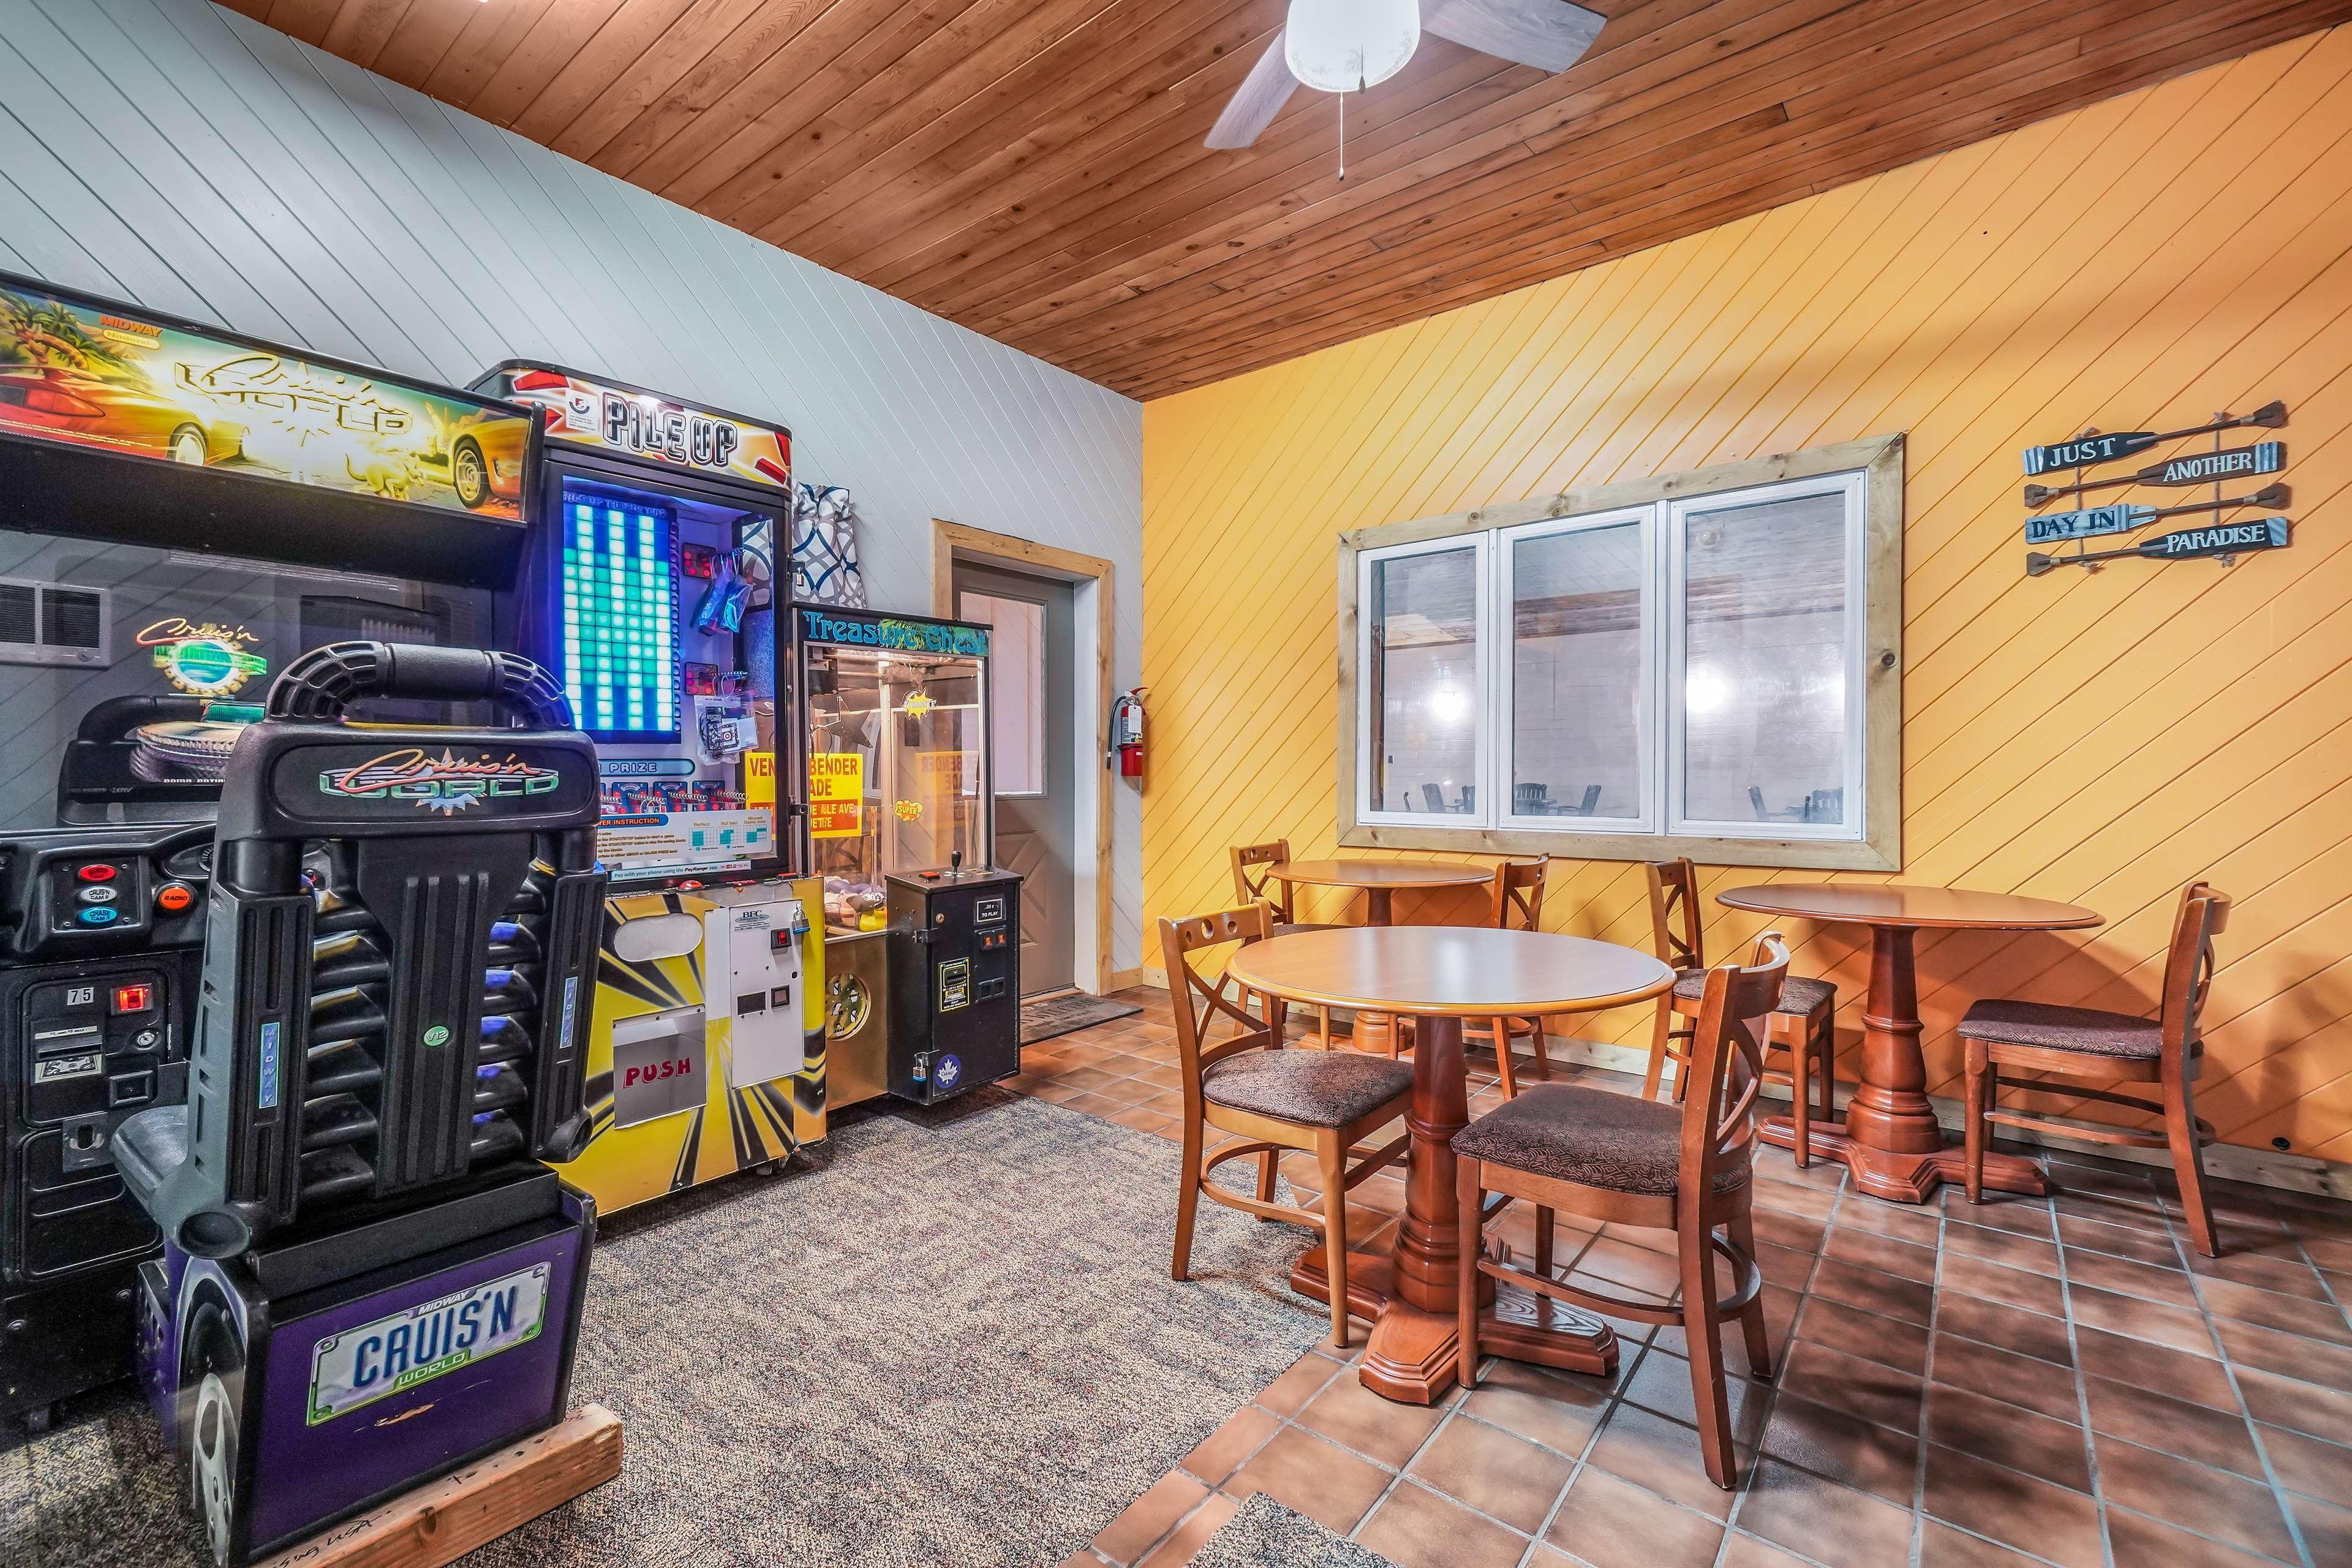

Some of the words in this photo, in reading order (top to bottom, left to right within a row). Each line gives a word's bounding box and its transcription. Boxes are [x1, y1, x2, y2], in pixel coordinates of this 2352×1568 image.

[100, 314, 163, 337] MIDWAY
[603, 392, 686, 463] PILE
[690, 416, 737, 467] UP
[2049, 437, 2116, 467] JUST
[2163, 452, 2253, 483] ANOTHER
[2031, 515, 2079, 538] DAY
[2089, 510, 2115, 530] IN
[2166, 525, 2266, 553] PARADISE
[136, 617, 260, 646] Cruis'n
[803, 611, 917, 648] Treasure
[925, 625, 989, 654] Chest
[339, 748, 542, 793] Cruis'n
[609, 762, 657, 774] PRIZE
[750, 758, 775, 777] VEN
[318, 773, 559, 799] WORLD
[809, 778, 832, 796] ADE
[71, 989, 91, 1003] 75
[426, 1031, 447, 1042] V12
[264, 1028, 275, 1102] MIDWAY
[623, 1057, 691, 1089] PUSH
[418, 1291, 470, 1316] MIDWAY
[353, 1286, 519, 1387] CRUIS'N
[399, 1352, 466, 1386] WORLD
